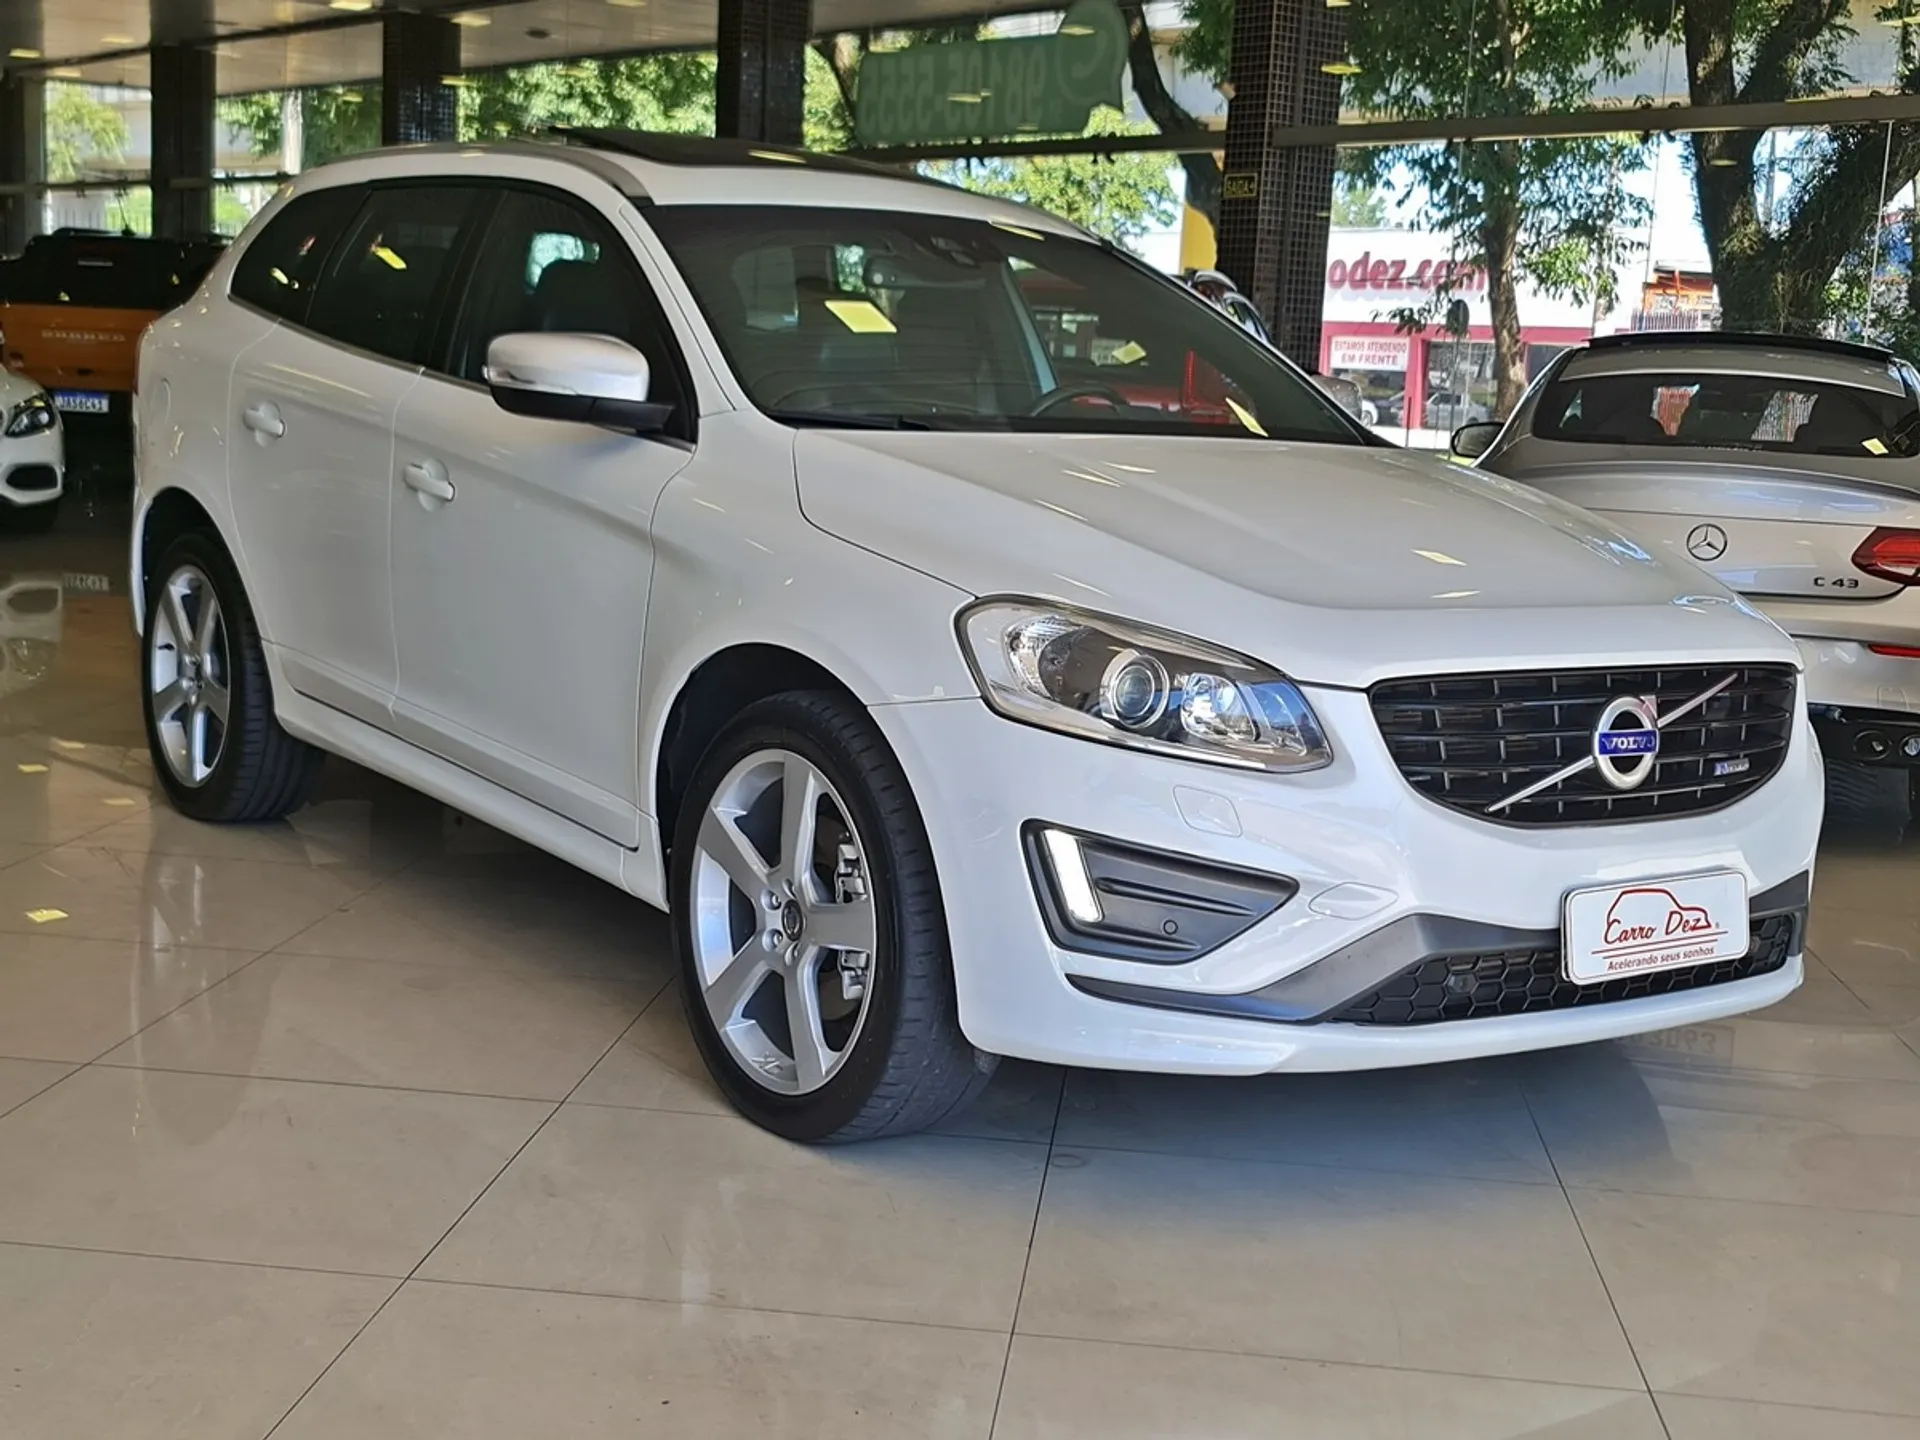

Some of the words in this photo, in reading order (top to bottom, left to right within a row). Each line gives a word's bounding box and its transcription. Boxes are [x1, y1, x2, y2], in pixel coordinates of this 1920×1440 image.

[1341, 353, 1355, 364] EM
[1358, 354, 1399, 365] FRENTE
[1813, 576, 1825, 587] C
[1831, 578, 1859, 588] 43
[1602, 735, 1656, 750] VOLVO
[1604, 918, 1657, 945] Carro
[1665, 911, 1706, 936] Dez
[1608, 955, 1659, 972] Acelerando
[1660, 953, 1681, 963] seus
[1683, 946, 1716, 960] sonhos
